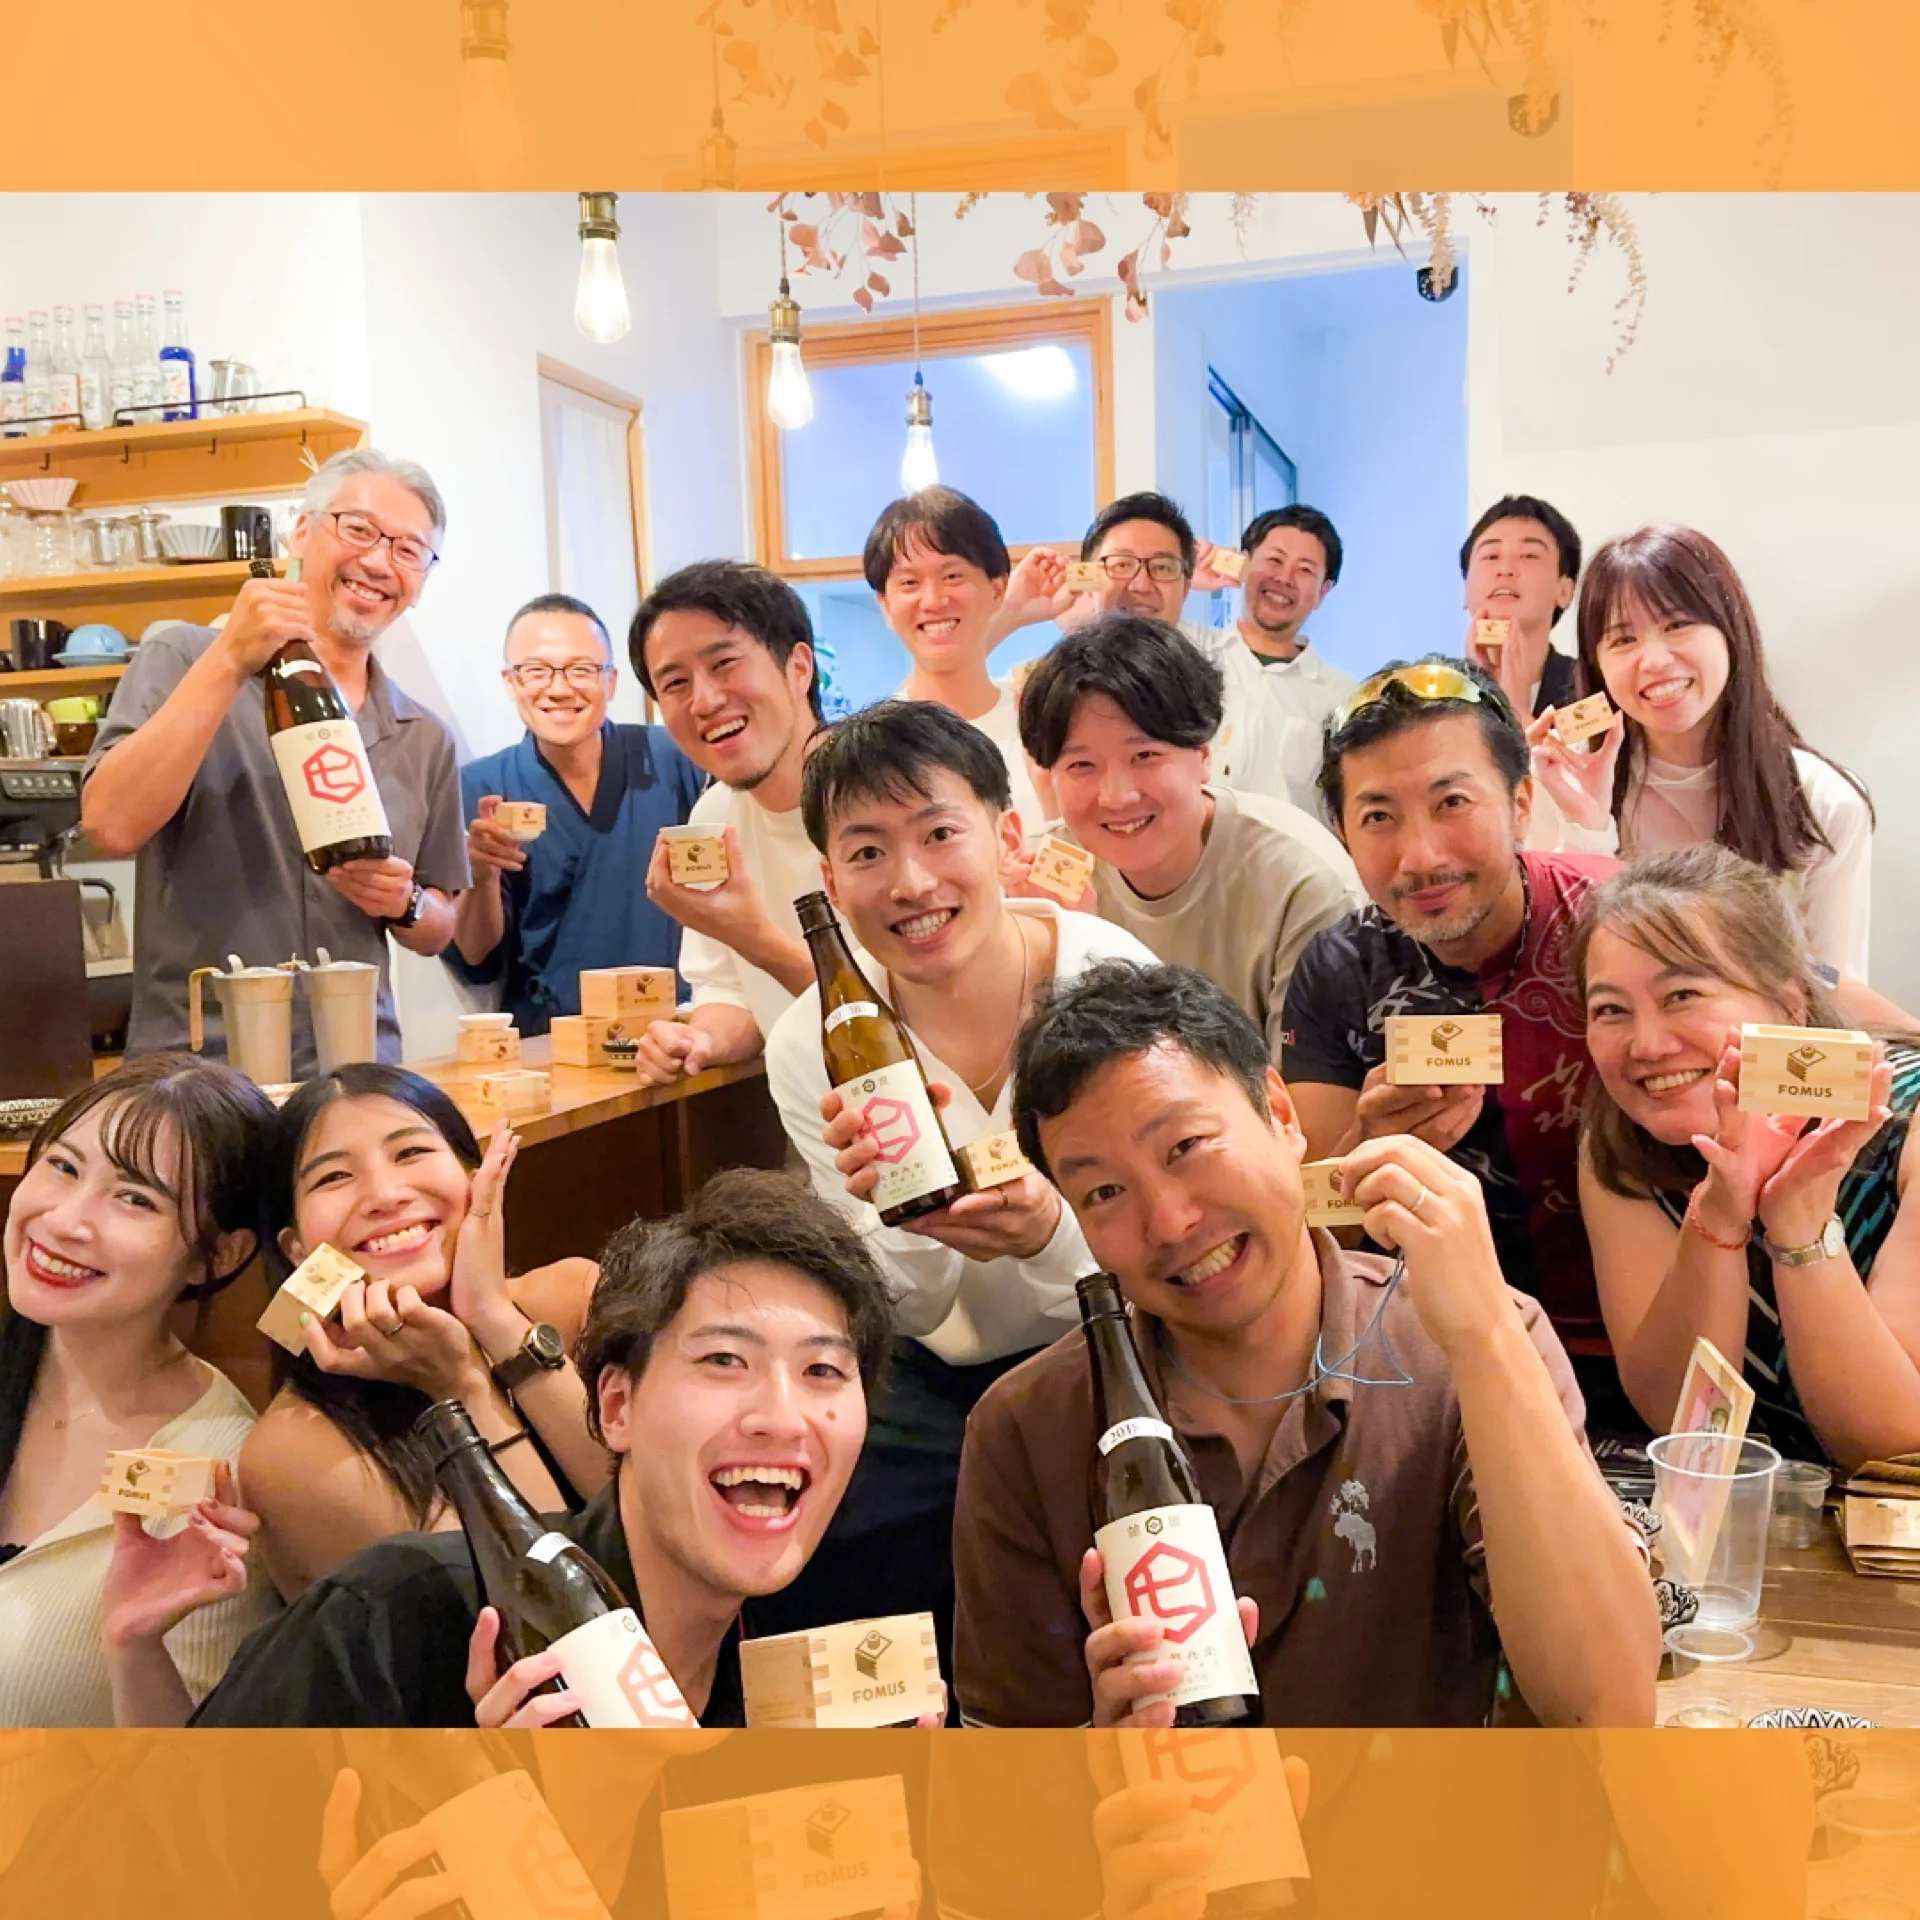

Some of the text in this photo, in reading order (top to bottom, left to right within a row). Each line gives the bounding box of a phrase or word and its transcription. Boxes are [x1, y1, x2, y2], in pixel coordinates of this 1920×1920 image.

[1426, 1057, 1472, 1067] FOMUS
[1778, 1084, 1832, 1098] FOMUS
[1327, 1199, 1361, 1210] FOMU
[852, 1680, 907, 1704] FOMUS
